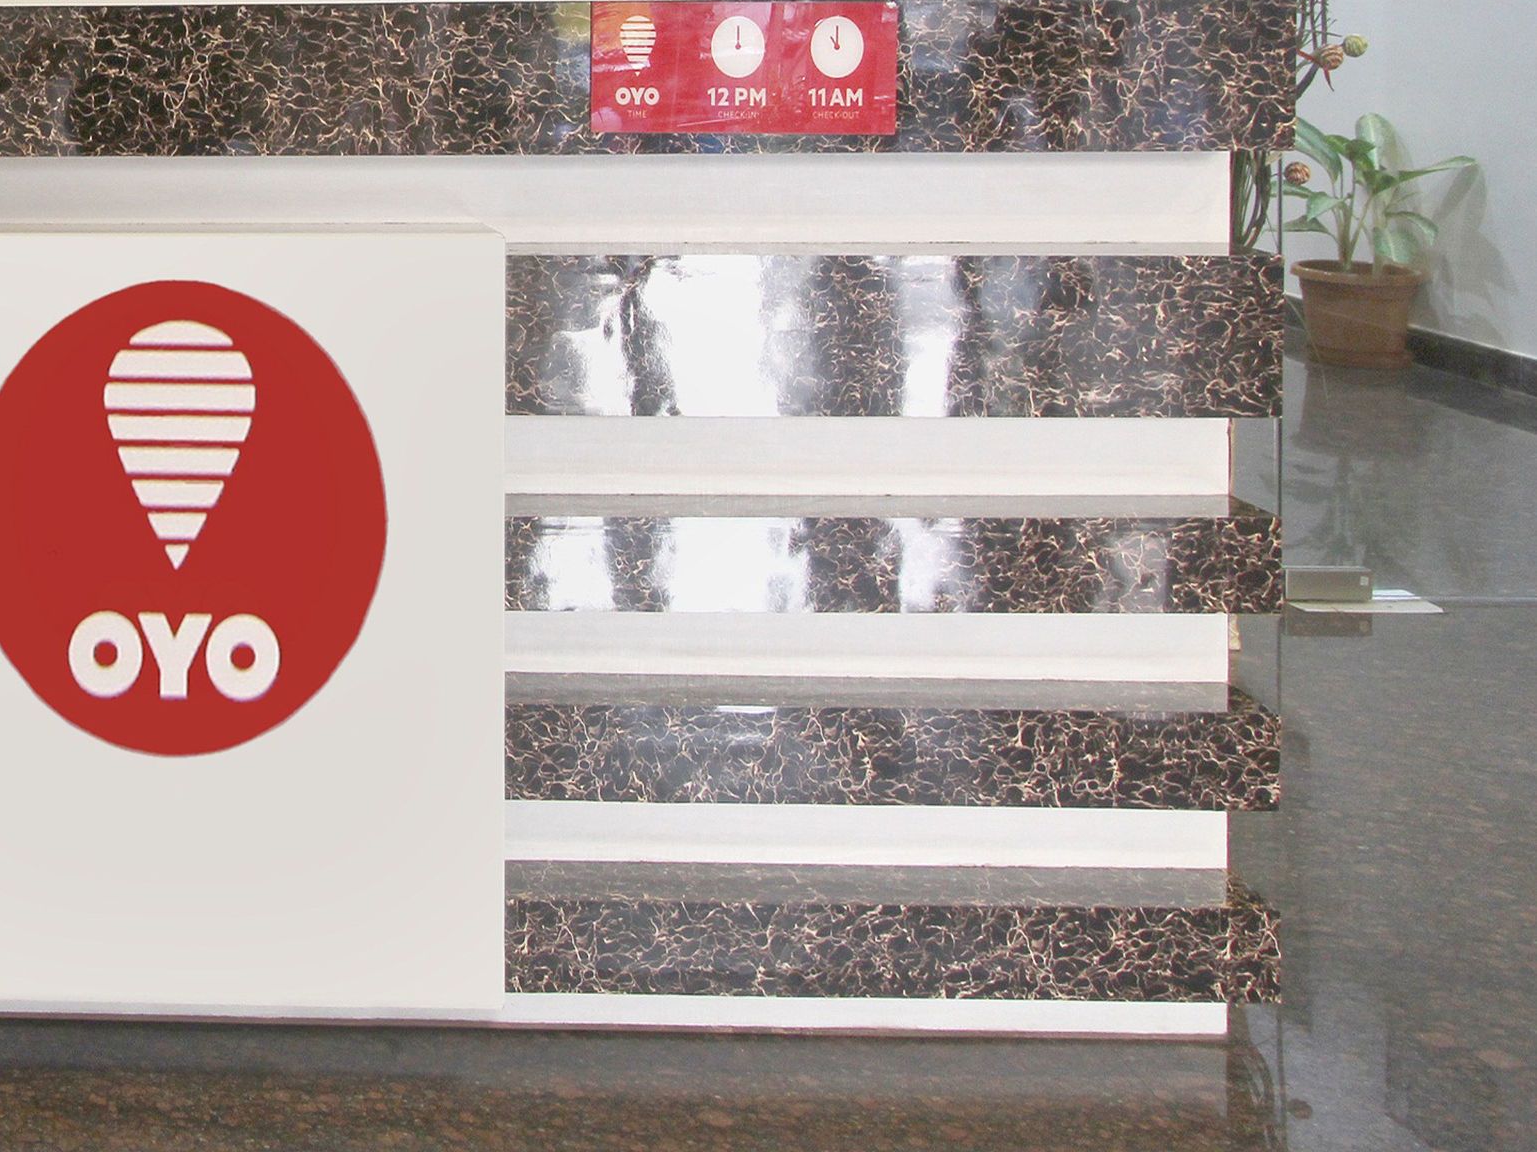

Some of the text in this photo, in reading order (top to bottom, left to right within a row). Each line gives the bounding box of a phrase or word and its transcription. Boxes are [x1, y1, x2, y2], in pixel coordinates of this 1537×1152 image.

[614, 87, 660, 106] OYO
[707, 87, 767, 107] 12 PM
[627, 110, 648, 119] TIME
[68, 610, 281, 703] OYO
